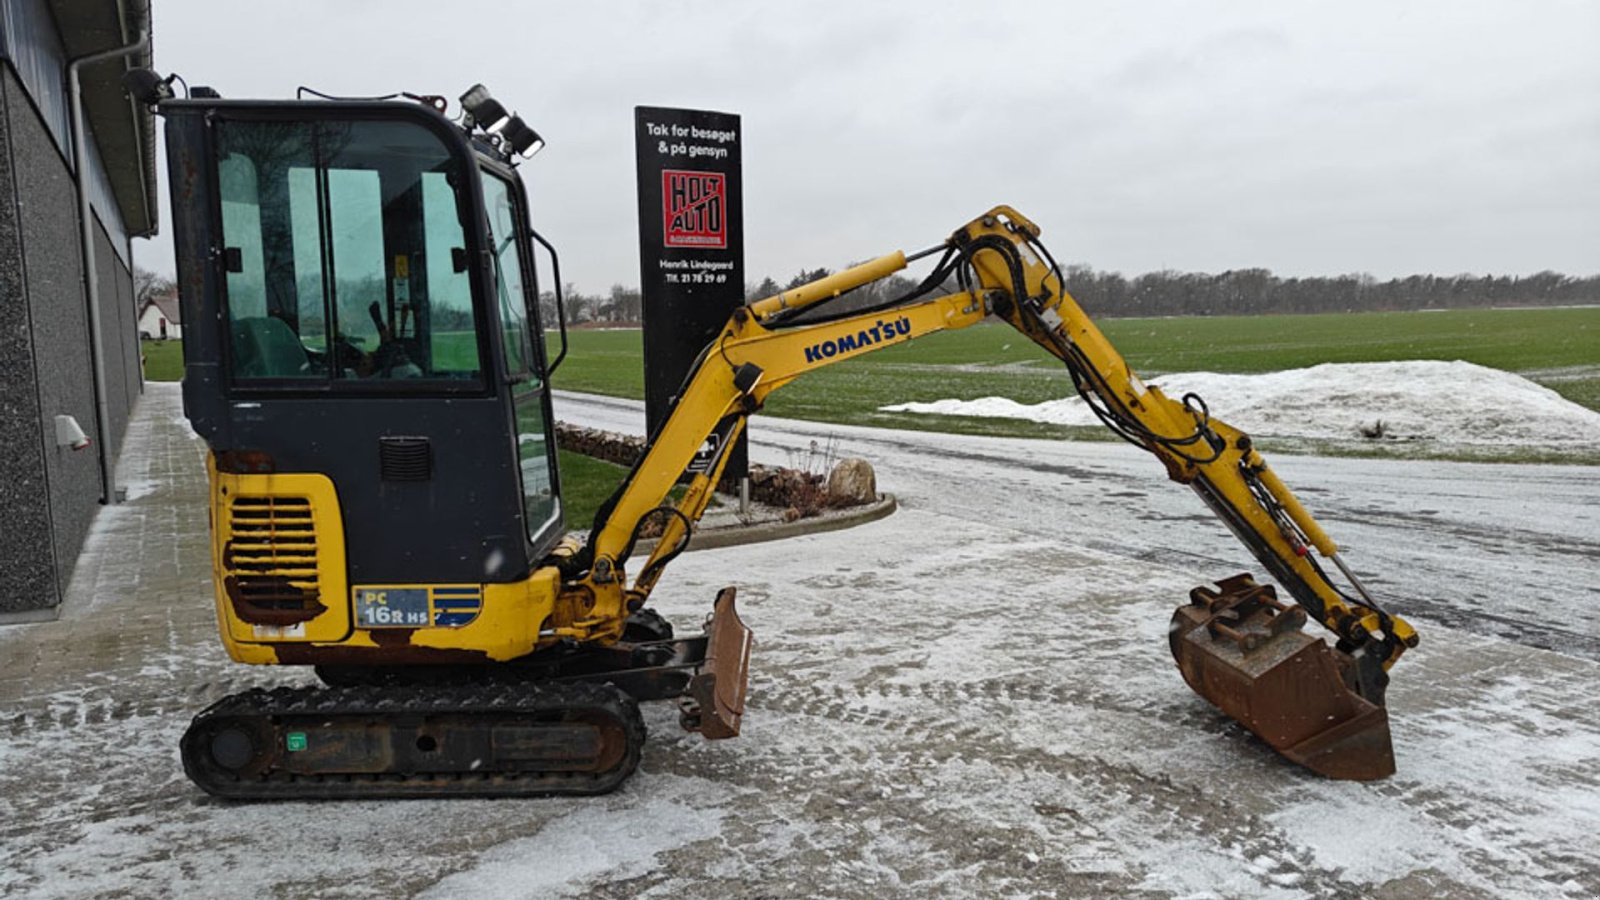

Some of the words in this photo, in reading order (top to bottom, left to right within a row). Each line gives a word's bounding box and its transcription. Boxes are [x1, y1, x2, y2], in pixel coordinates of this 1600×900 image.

[646, 122, 669, 136] Tak
[671, 123, 690, 137] for
[691, 125, 736, 143] besøget
[658, 140, 669, 154] &
[670, 142, 687, 157] på
[689, 145, 728, 160] gensyn
[670, 174, 720, 213] HOLT
[670, 195, 721, 233] AUTO
[659, 259, 689, 269] Henrik
[704, 273, 715, 283] 29
[804, 316, 911, 363] KOMATSU
[365, 592, 388, 605] PC
[365, 606, 404, 624] 16R
[407, 612, 428, 623] HS
